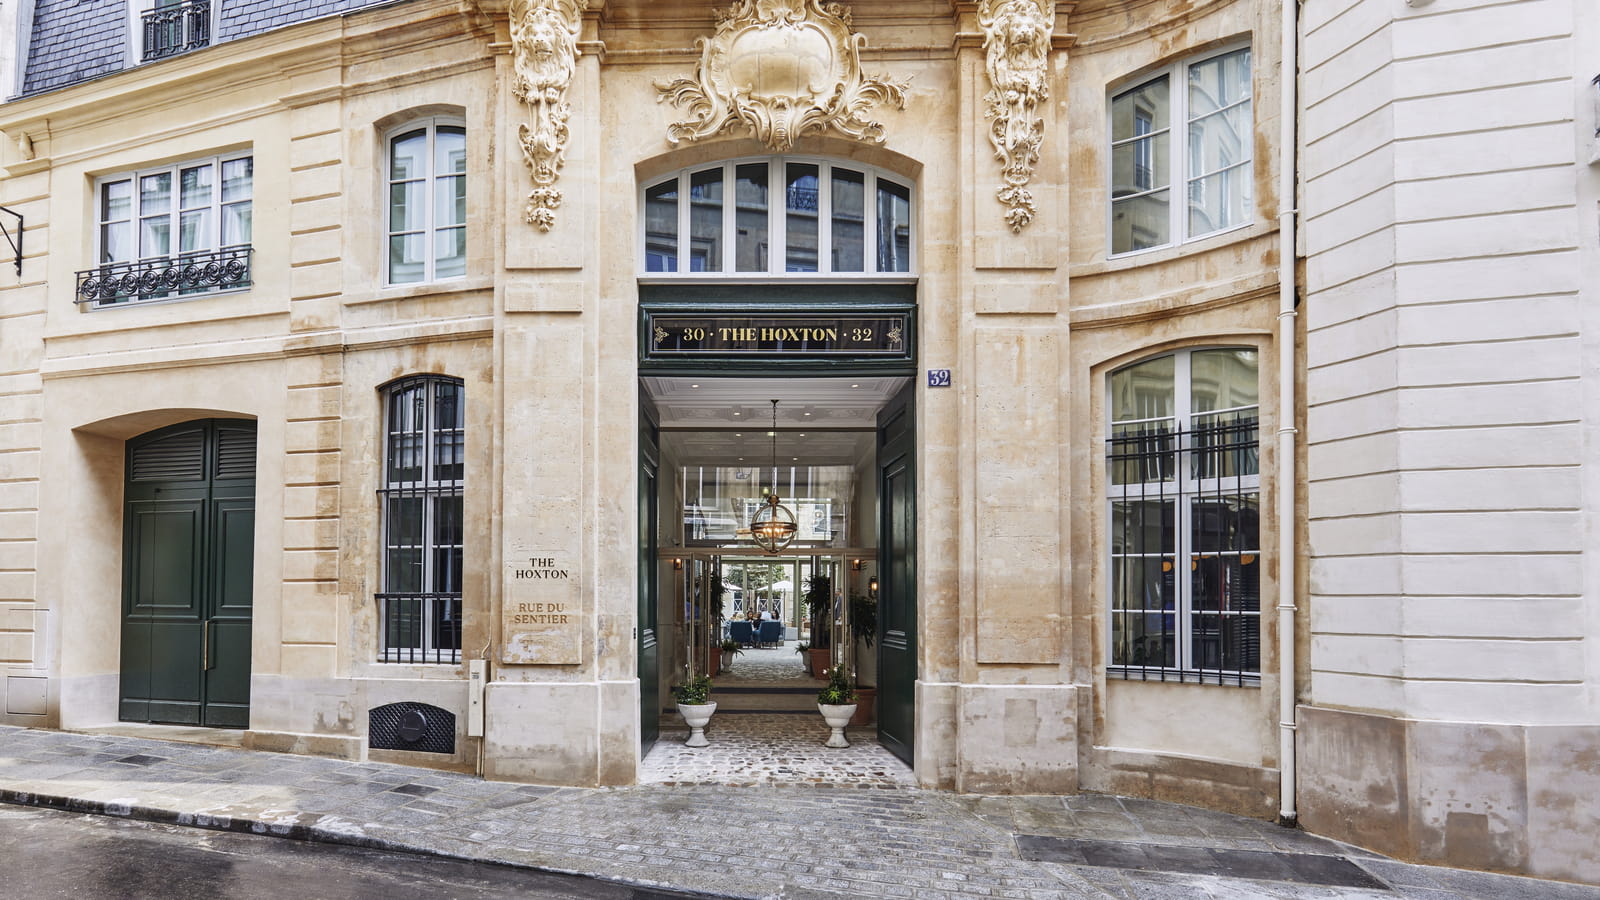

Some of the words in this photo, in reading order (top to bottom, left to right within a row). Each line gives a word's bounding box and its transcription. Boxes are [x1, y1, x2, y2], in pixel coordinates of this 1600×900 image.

[683, 327, 705, 341] 30
[718, 327, 757, 341] THE
[761, 327, 837, 341] HOXTON
[852, 327, 873, 341] 32
[930, 370, 949, 386] 32
[529, 557, 555, 568] THE
[515, 569, 569, 579] HOXTON
[519, 602, 544, 613] RUE
[547, 602, 565, 613] DU
[514, 614, 568, 624] SENTIER
